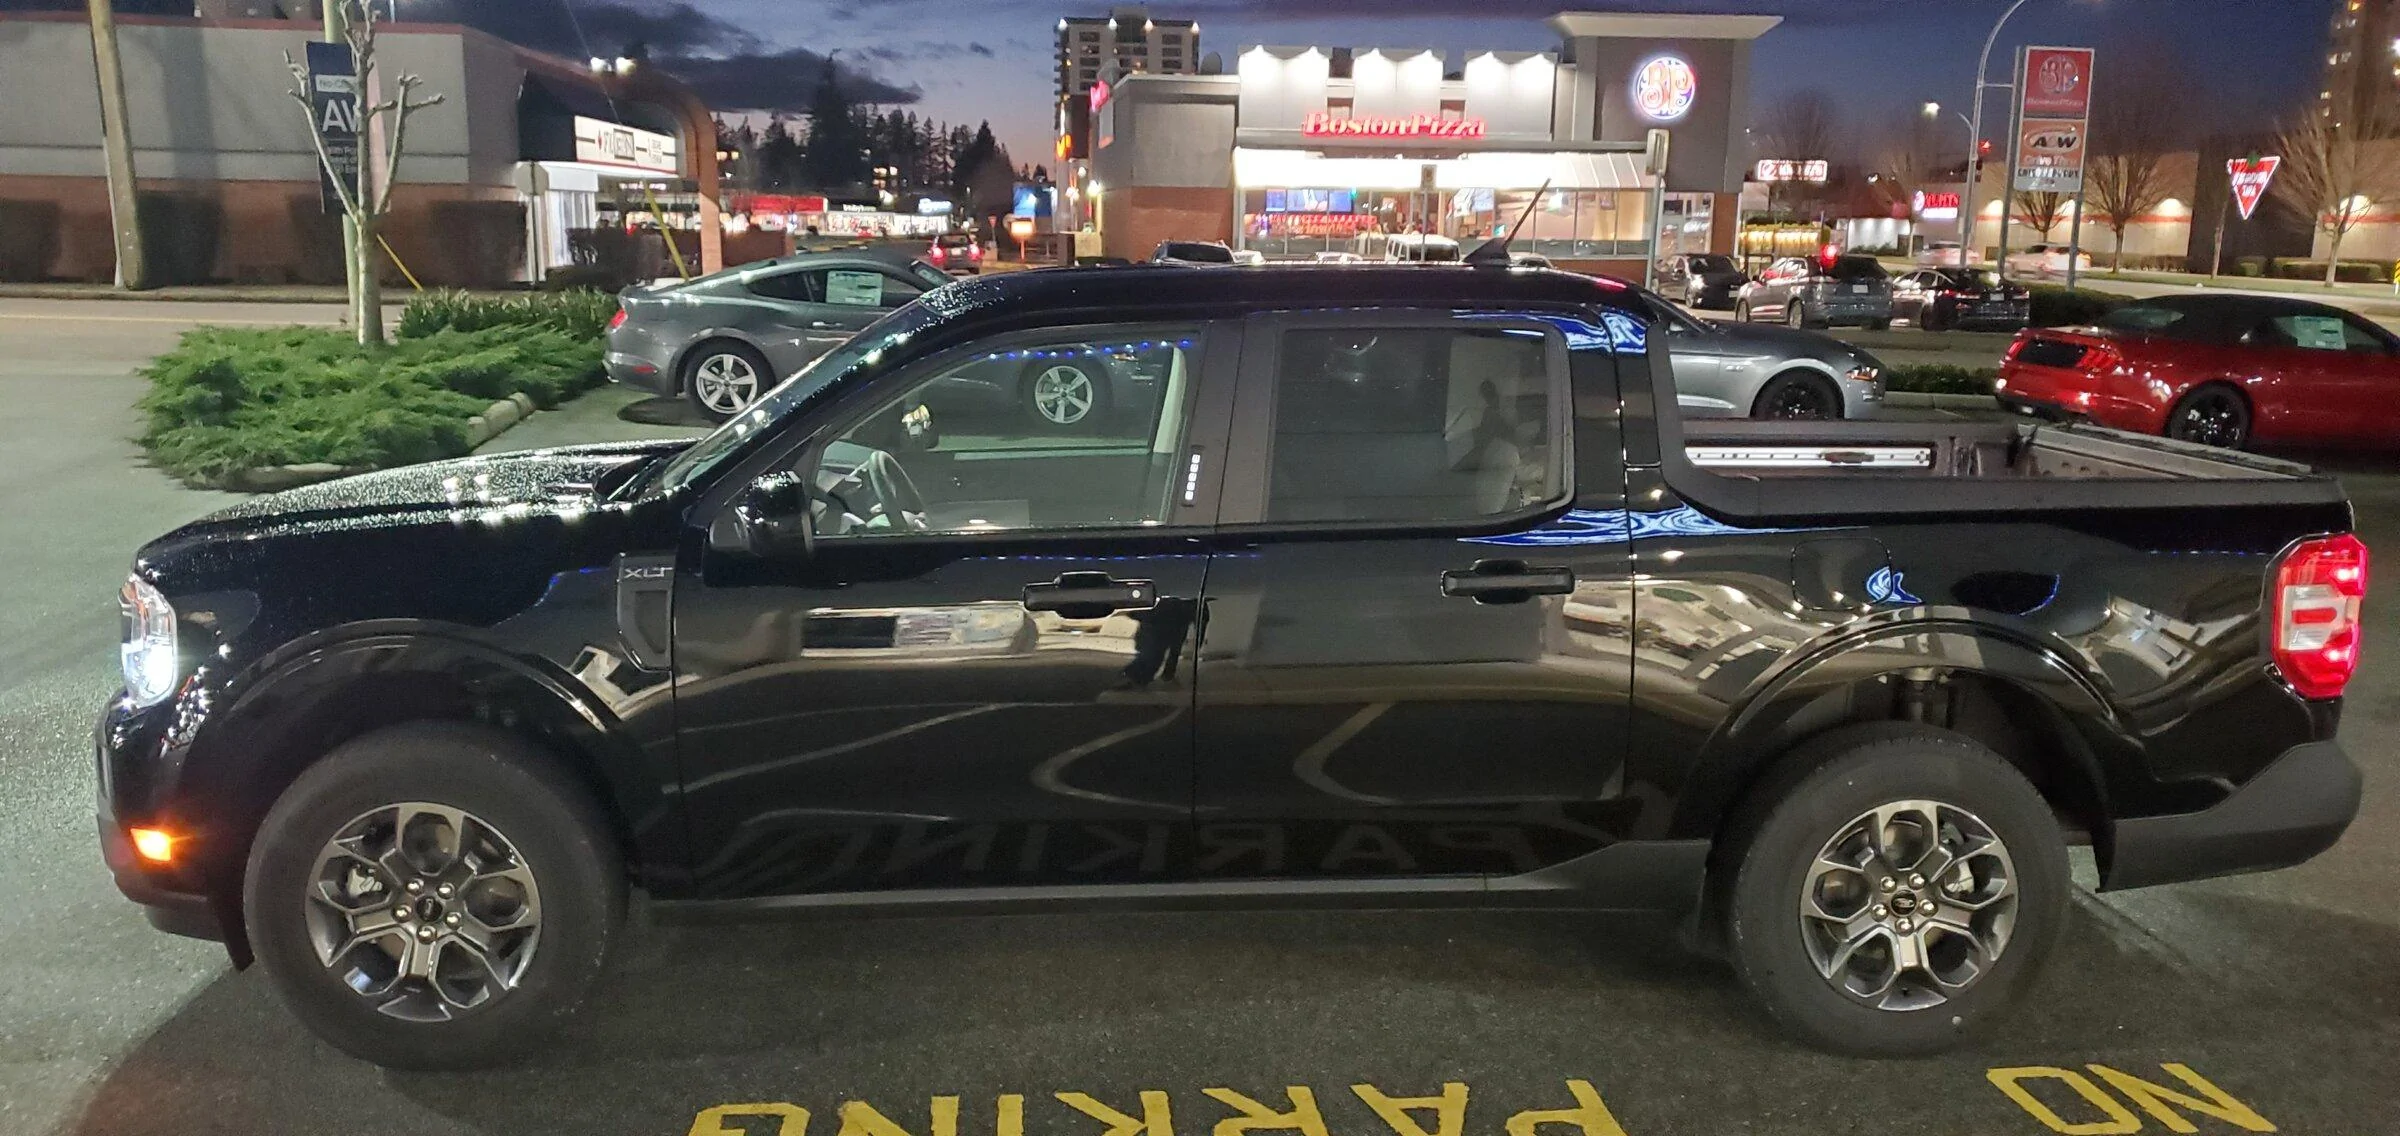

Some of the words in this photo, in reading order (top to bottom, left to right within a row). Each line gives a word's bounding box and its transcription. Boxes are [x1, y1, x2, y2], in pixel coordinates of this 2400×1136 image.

[1302, 112, 1410, 136] Boston
[1408, 113, 1486, 136] Pizza
[624, 567, 674, 579] XLT
[1986, 1062, 2277, 1136] NO
